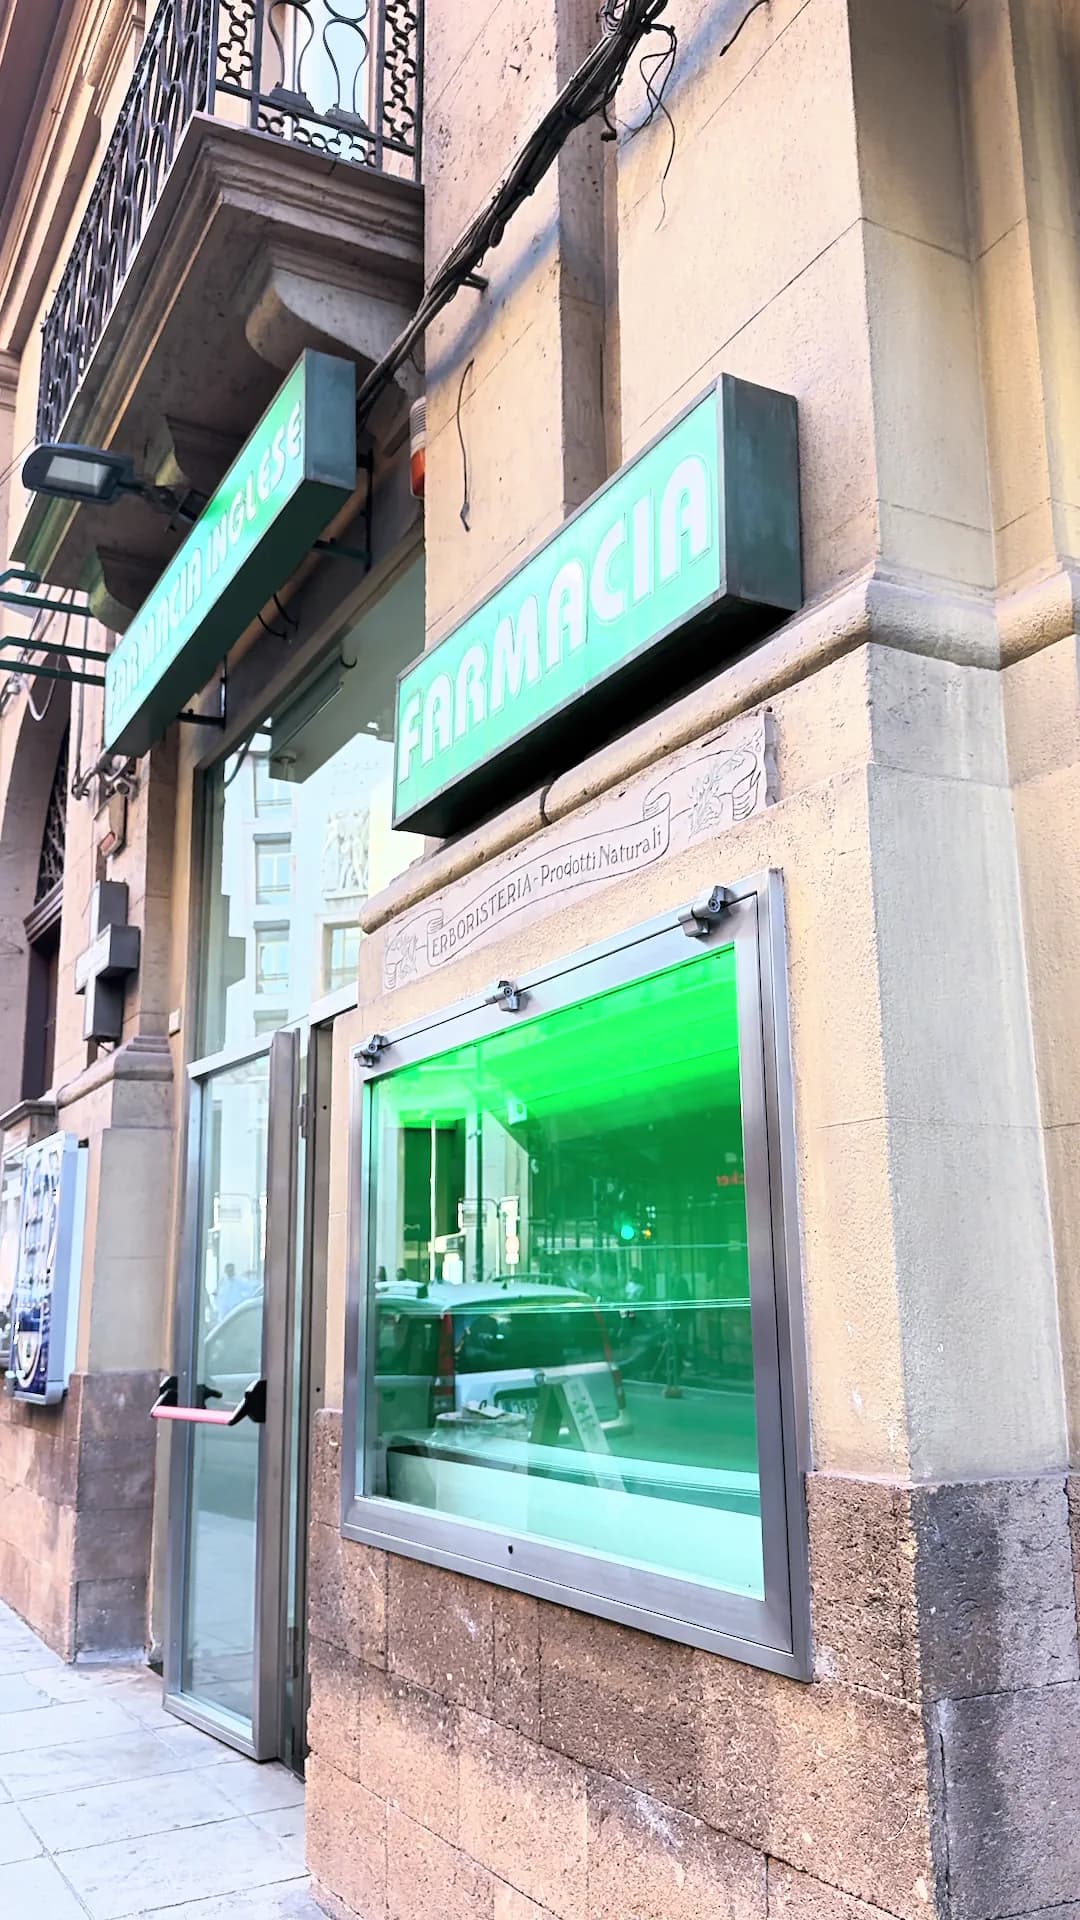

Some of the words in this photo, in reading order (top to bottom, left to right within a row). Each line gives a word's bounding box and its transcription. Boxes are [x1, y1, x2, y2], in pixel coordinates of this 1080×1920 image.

[107, 546, 202, 725] FARMACIA
[206, 399, 301, 583] INGLESE
[399, 455, 712, 785] FARMACIA
[599, 825, 662, 868] Naturali
